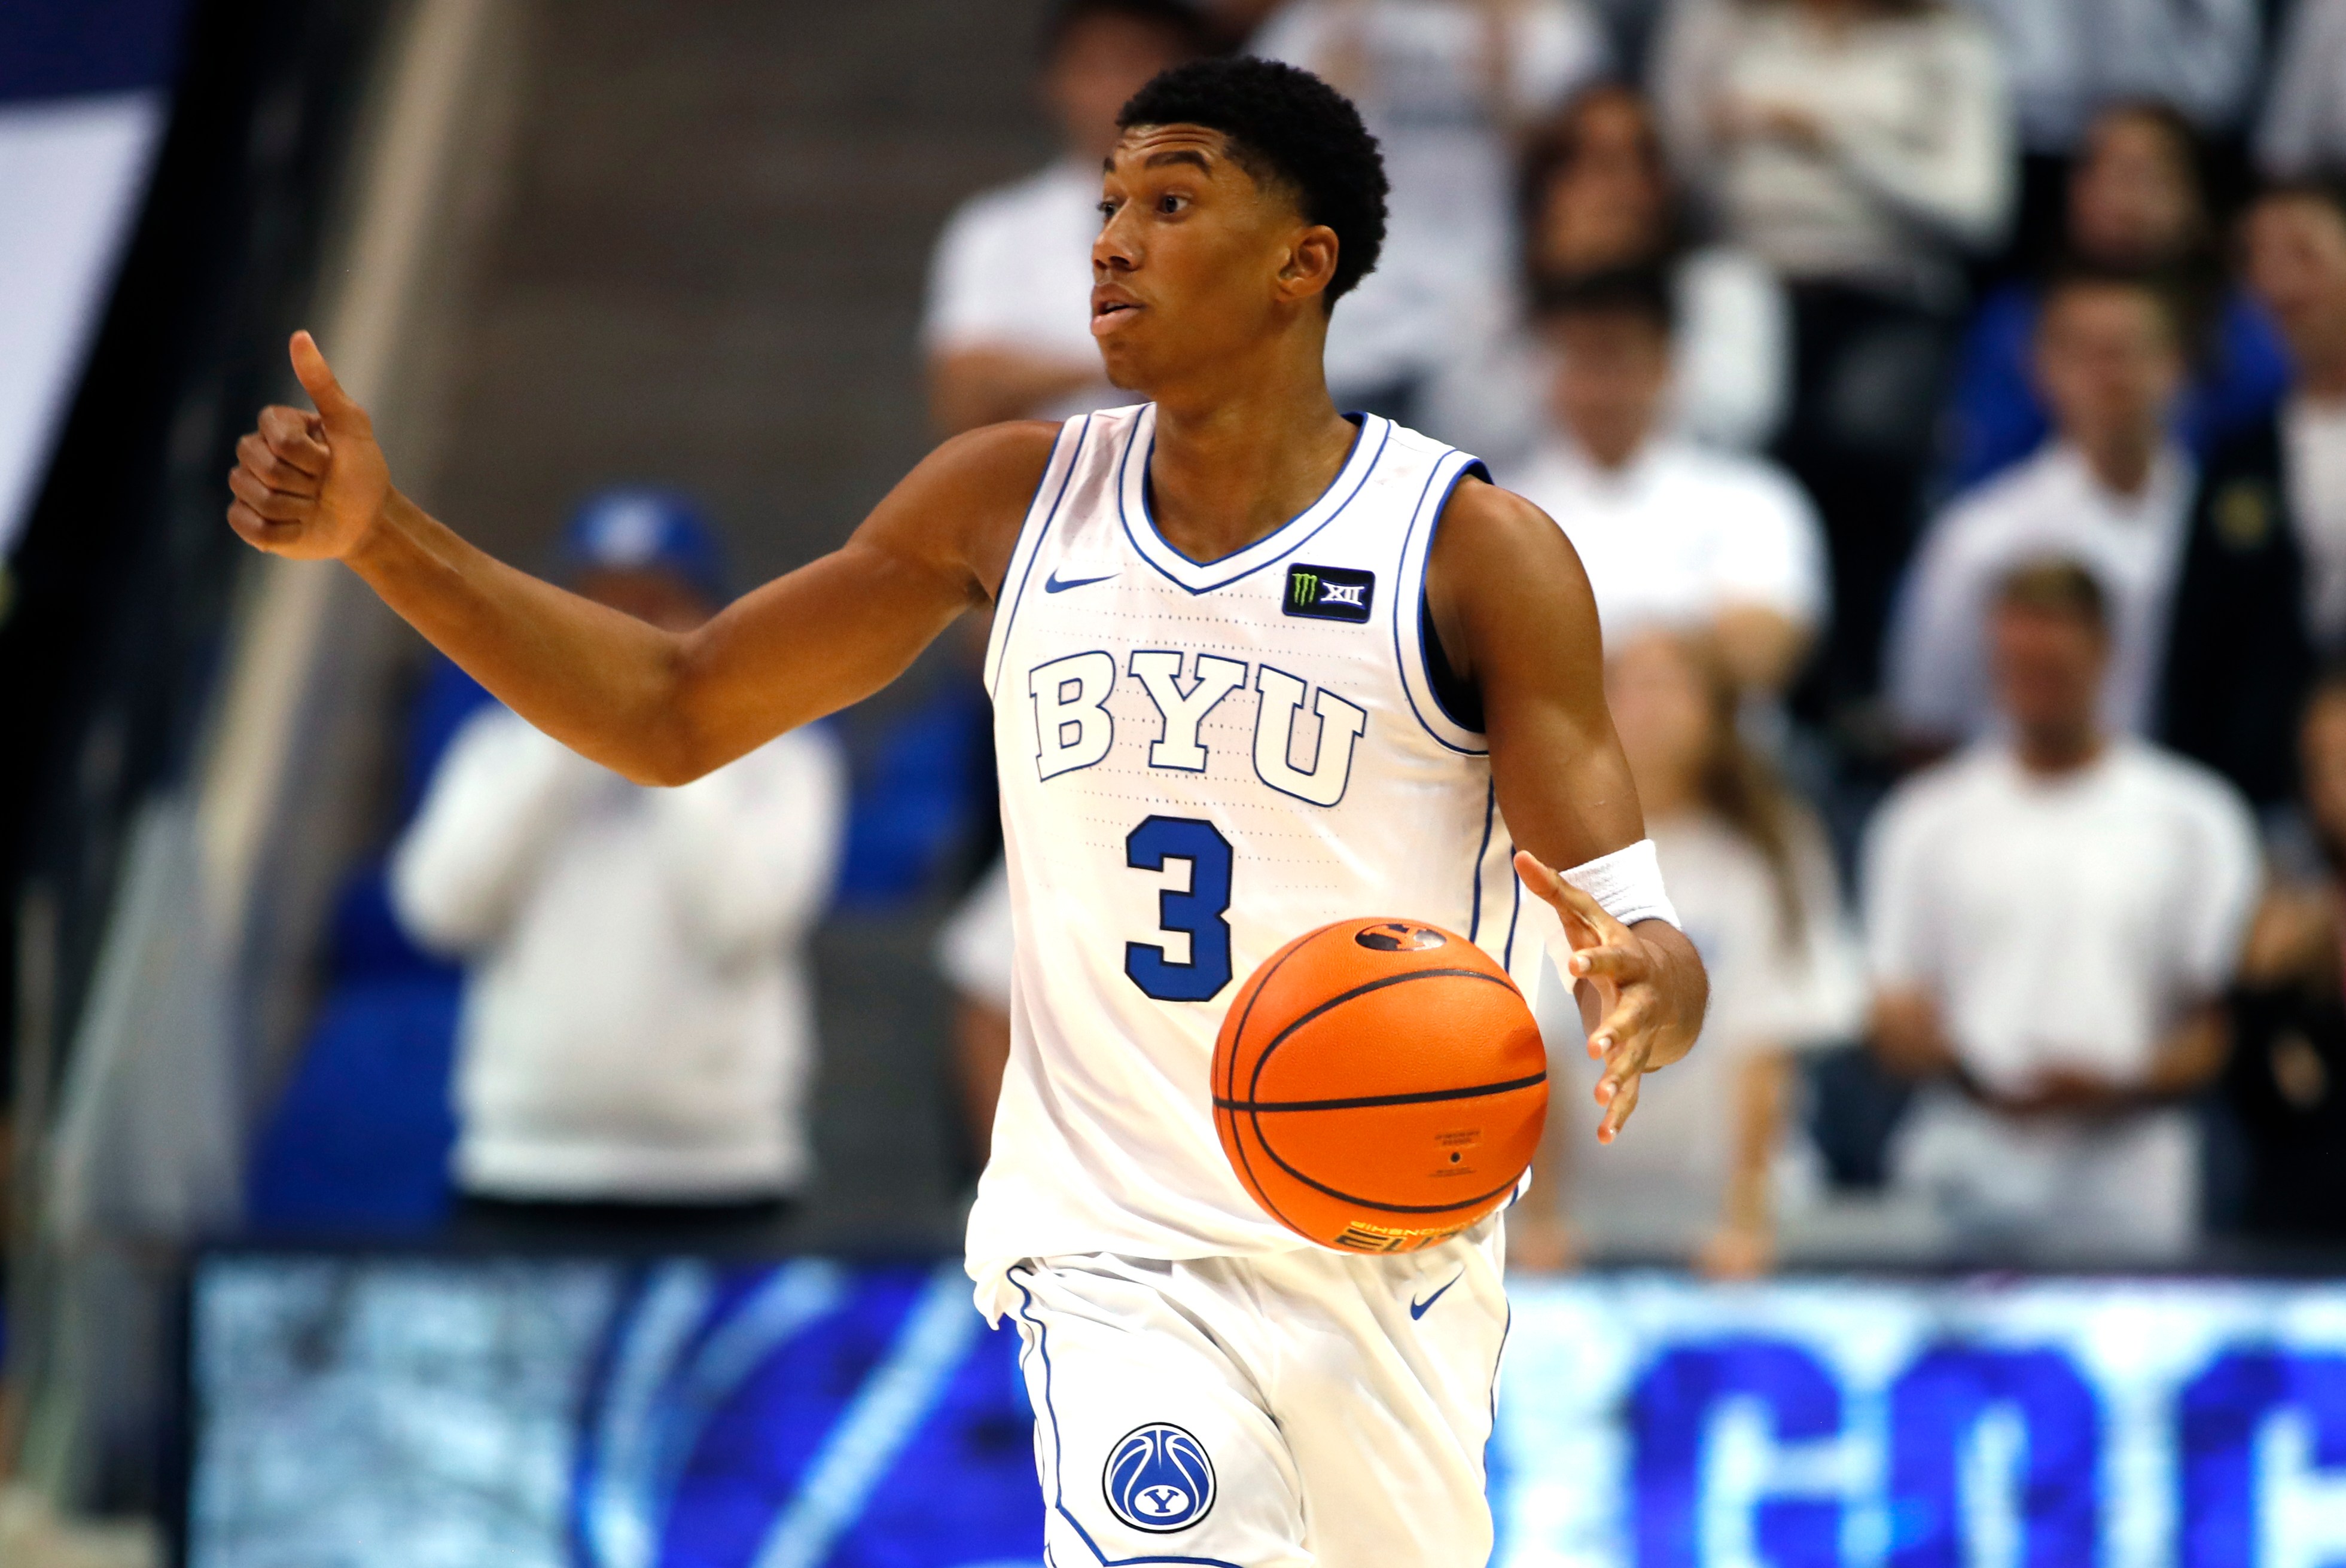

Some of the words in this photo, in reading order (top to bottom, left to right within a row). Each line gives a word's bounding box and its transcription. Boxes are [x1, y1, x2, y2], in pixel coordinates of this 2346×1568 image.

[1029, 649, 1367, 808] BYU
[1125, 814, 1233, 1002] 3
[1144, 1489, 1180, 1513] Y
